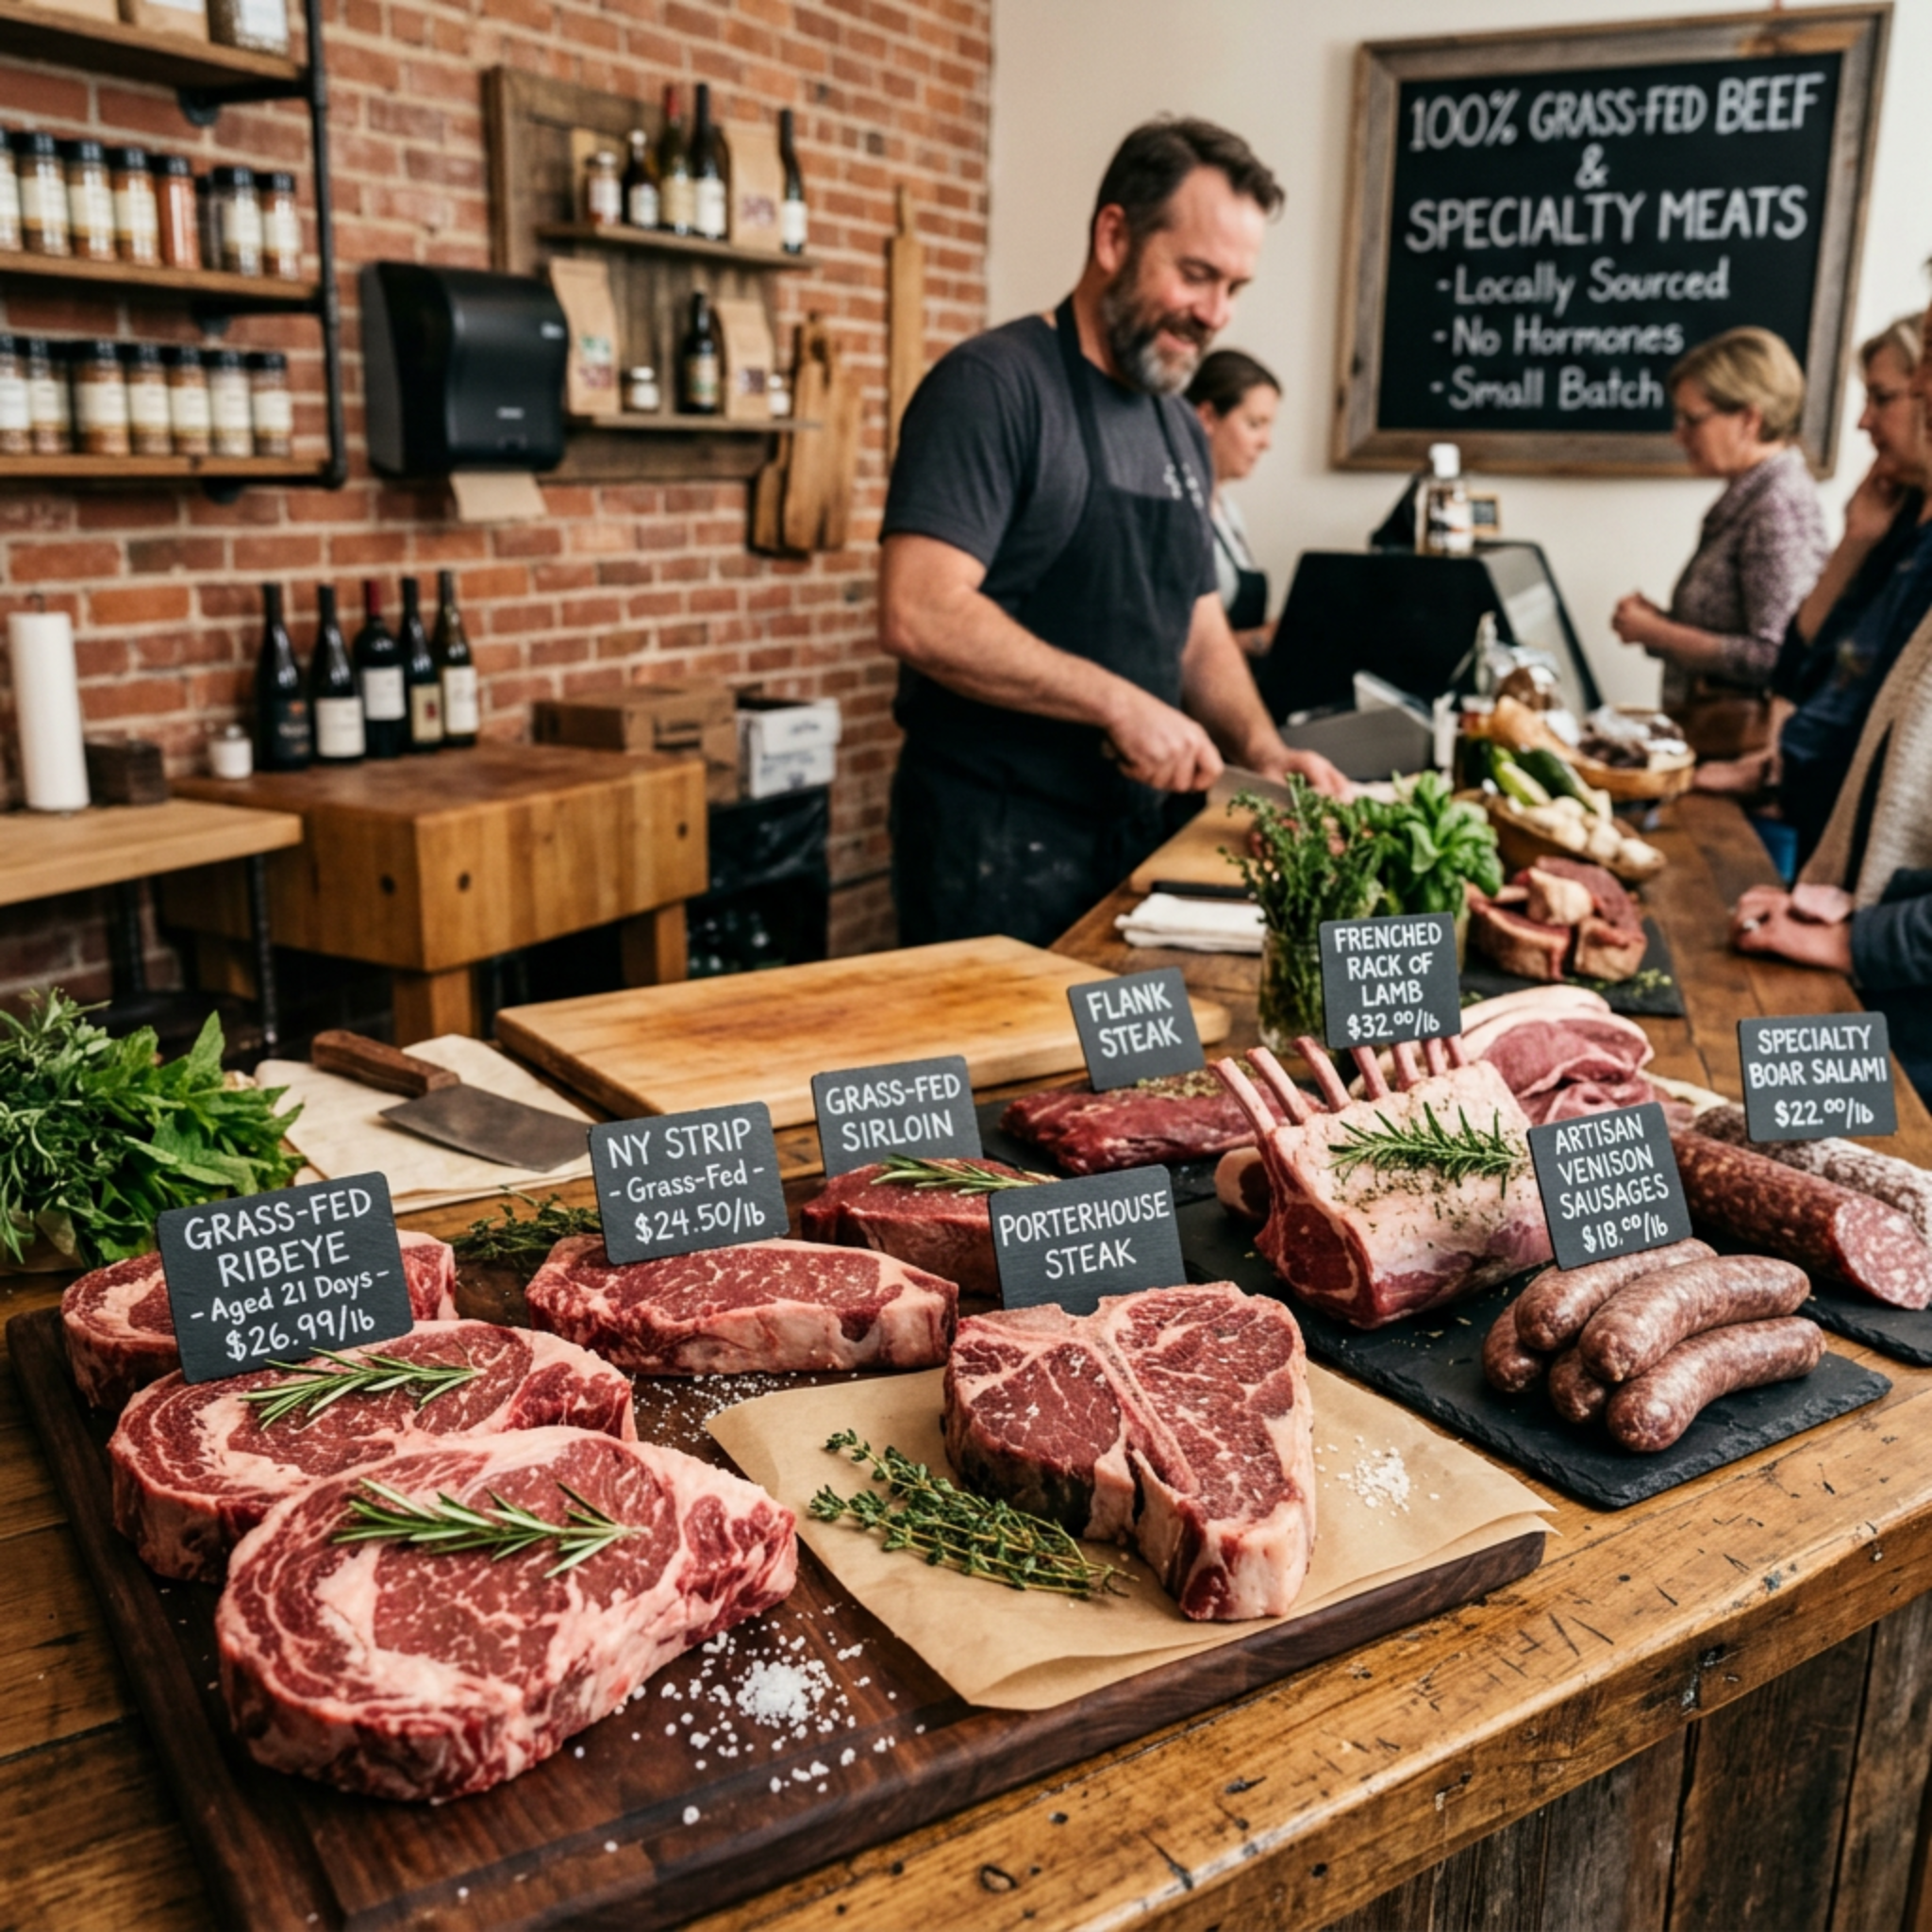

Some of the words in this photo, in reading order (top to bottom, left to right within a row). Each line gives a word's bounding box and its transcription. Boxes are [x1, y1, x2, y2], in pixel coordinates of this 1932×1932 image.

[1413, 91, 1518, 150] 100%
[1529, 86, 1707, 141] GRASS-FED
[1715, 73, 1824, 134] BEEF
[1575, 144, 1607, 189] &
[1407, 193, 1645, 251] SPECIALTY
[1658, 185, 1807, 241] MEATS
[1589, 257, 1729, 302] Sourced
[1514, 316, 1683, 354] Hormones
[1559, 367, 1663, 409] Batch
[1334, 922, 1442, 953] FRENCHED
[1347, 954, 1403, 981] RACK
[1408, 952, 1434, 974] OF
[1086, 982, 1173, 1023] FLANK
[1361, 979, 1424, 1007] LAMB
[1098, 1016, 1182, 1059] STEAK
[1757, 1024, 1872, 1055] SPECIALTY
[825, 1073, 961, 1115] GRASS-FED
[1748, 1060, 1807, 1090] BOAR
[1811, 1057, 1887, 1084] SALAMI
[607, 1130, 651, 1169] NY
[665, 1118, 752, 1159] STRIP
[841, 1108, 955, 1152] SIRLOIN
[1556, 1113, 1644, 1156] ARTISAN
[626, 1158, 748, 1203] Grass-Fed
[1557, 1143, 1655, 1186] VENISON
[998, 1190, 1171, 1247] PORTERHOUSE
[1559, 1173, 1669, 1220] SAUSAGES
[184, 1188, 373, 1250] GRASS-FED
[634, 1197, 766, 1245] $24.50/lb
[217, 1230, 350, 1288] RIBEYE
[1044, 1237, 1137, 1279] STEAK
[210, 1287, 275, 1325] Aged
[281, 1280, 308, 1307] 21
[314, 1271, 373, 1300] Days
[225, 1304, 375, 1361] $26.99/lb
